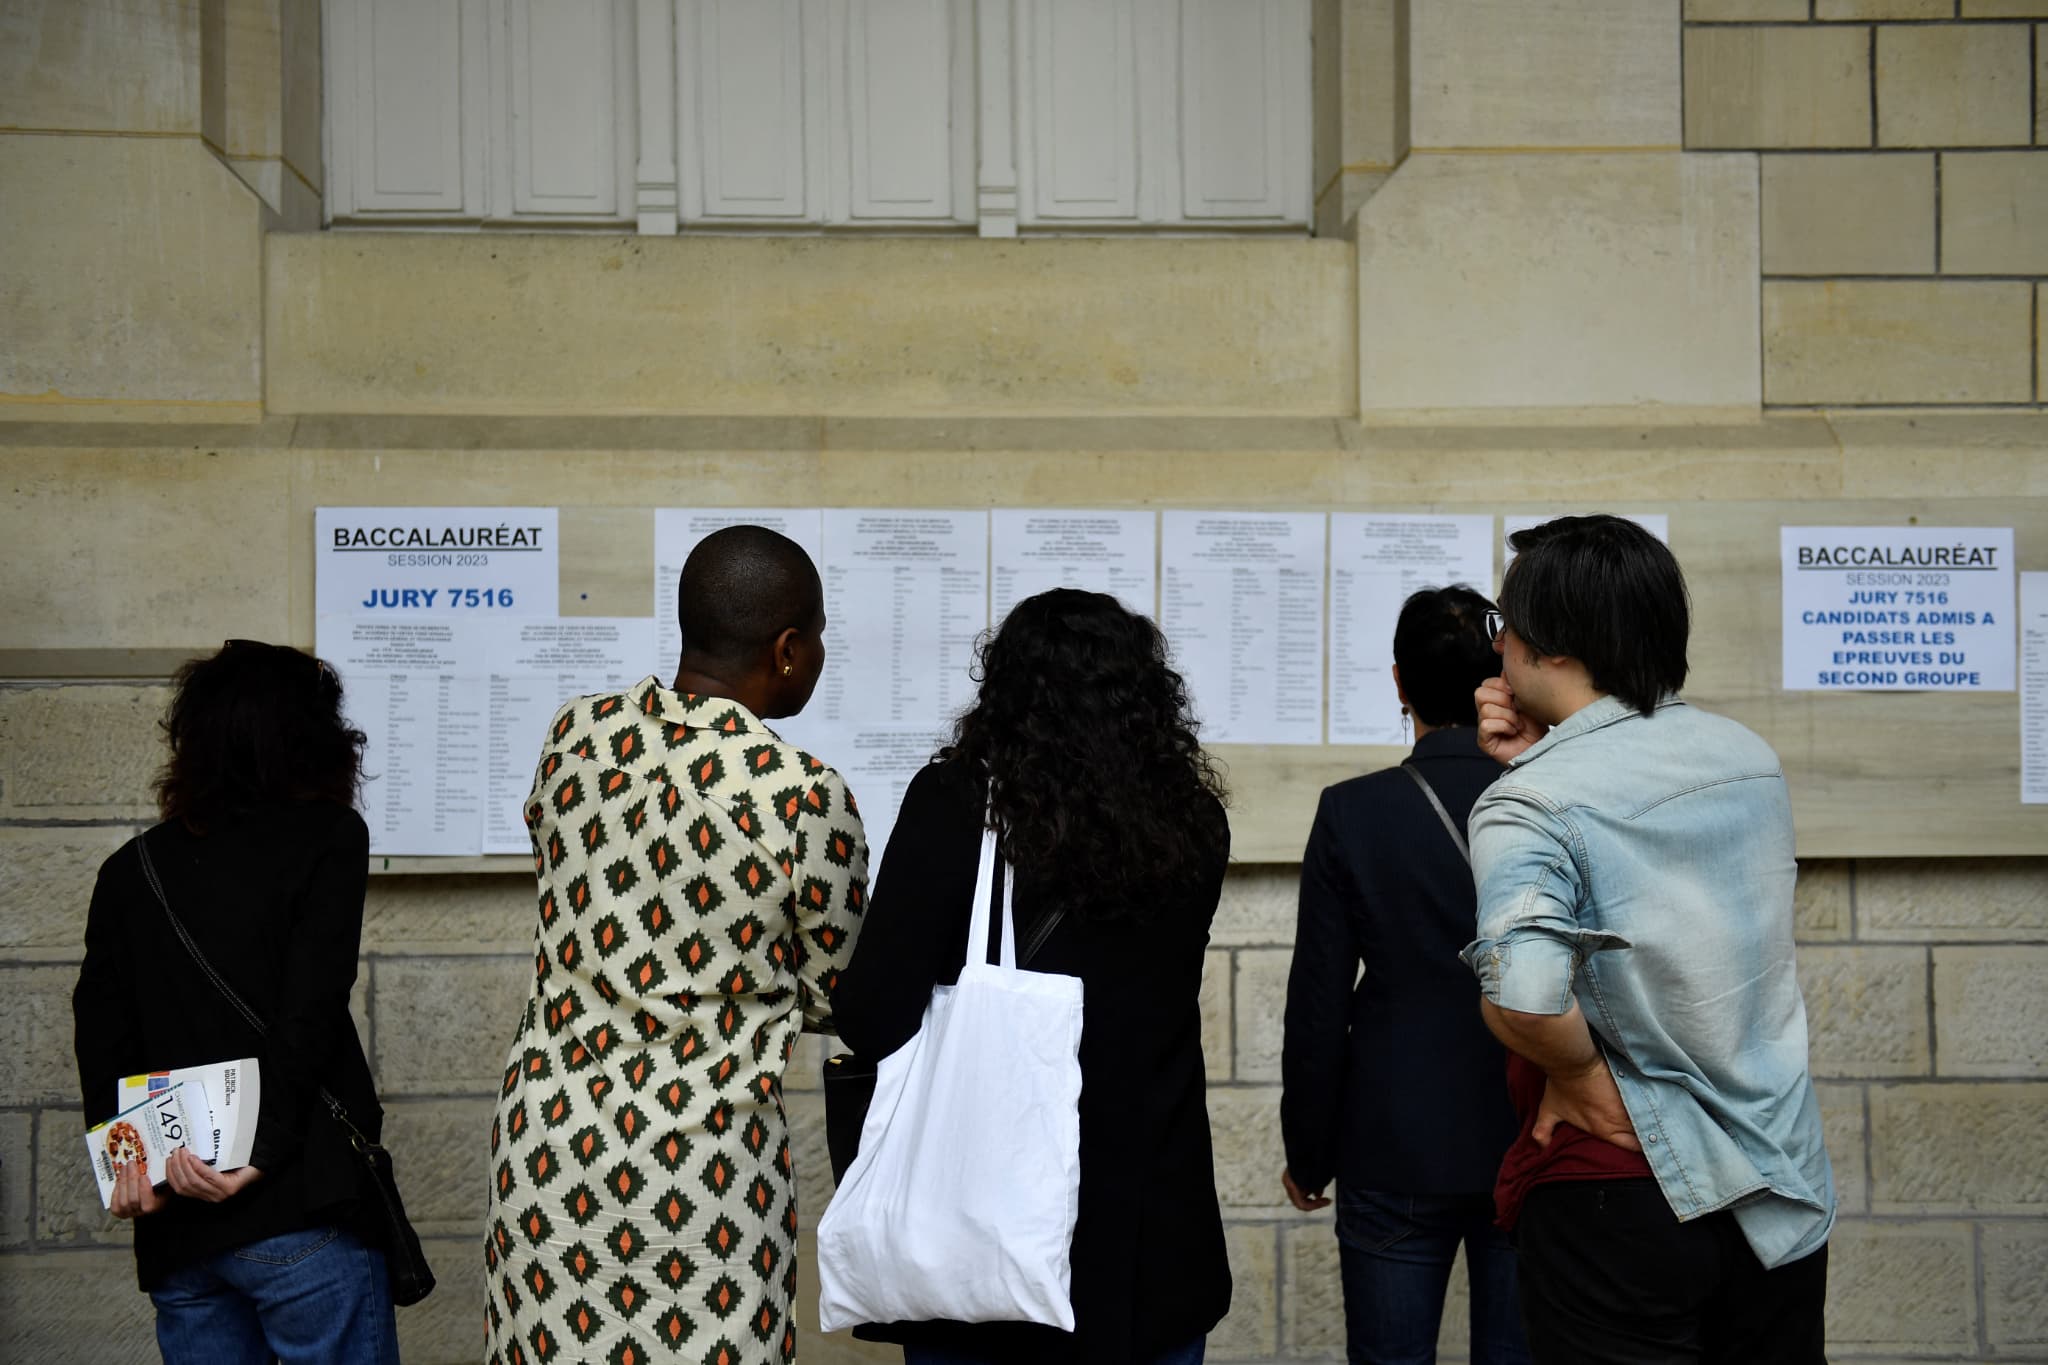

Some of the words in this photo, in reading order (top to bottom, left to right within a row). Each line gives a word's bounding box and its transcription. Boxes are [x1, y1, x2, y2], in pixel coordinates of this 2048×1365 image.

[334, 522, 542, 548] BACCALAURÉAT
[388, 554, 452, 567] SESSION
[456, 554, 488, 567] 2023
[1798, 542, 1998, 566] BACCALAURÉAT
[1846, 572, 1912, 586] SESSION
[1917, 572, 1950, 586] 2023
[362, 588, 438, 609] JURY
[448, 588, 514, 608] 7516
[1848, 591, 1898, 605] JURY
[1905, 591, 1948, 605] 7516
[1802, 611, 1910, 625] CANDIDATS
[1916, 611, 1976, 625] ADMIS
[1982, 611, 1995, 625] A
[1842, 631, 1915, 645] PASSER
[1921, 631, 1955, 645] LES
[1833, 651, 1933, 665] EPREUVES
[1939, 651, 1965, 665] DU
[1818, 671, 1898, 686] SECOND
[1904, 671, 1981, 686] GROUPE
